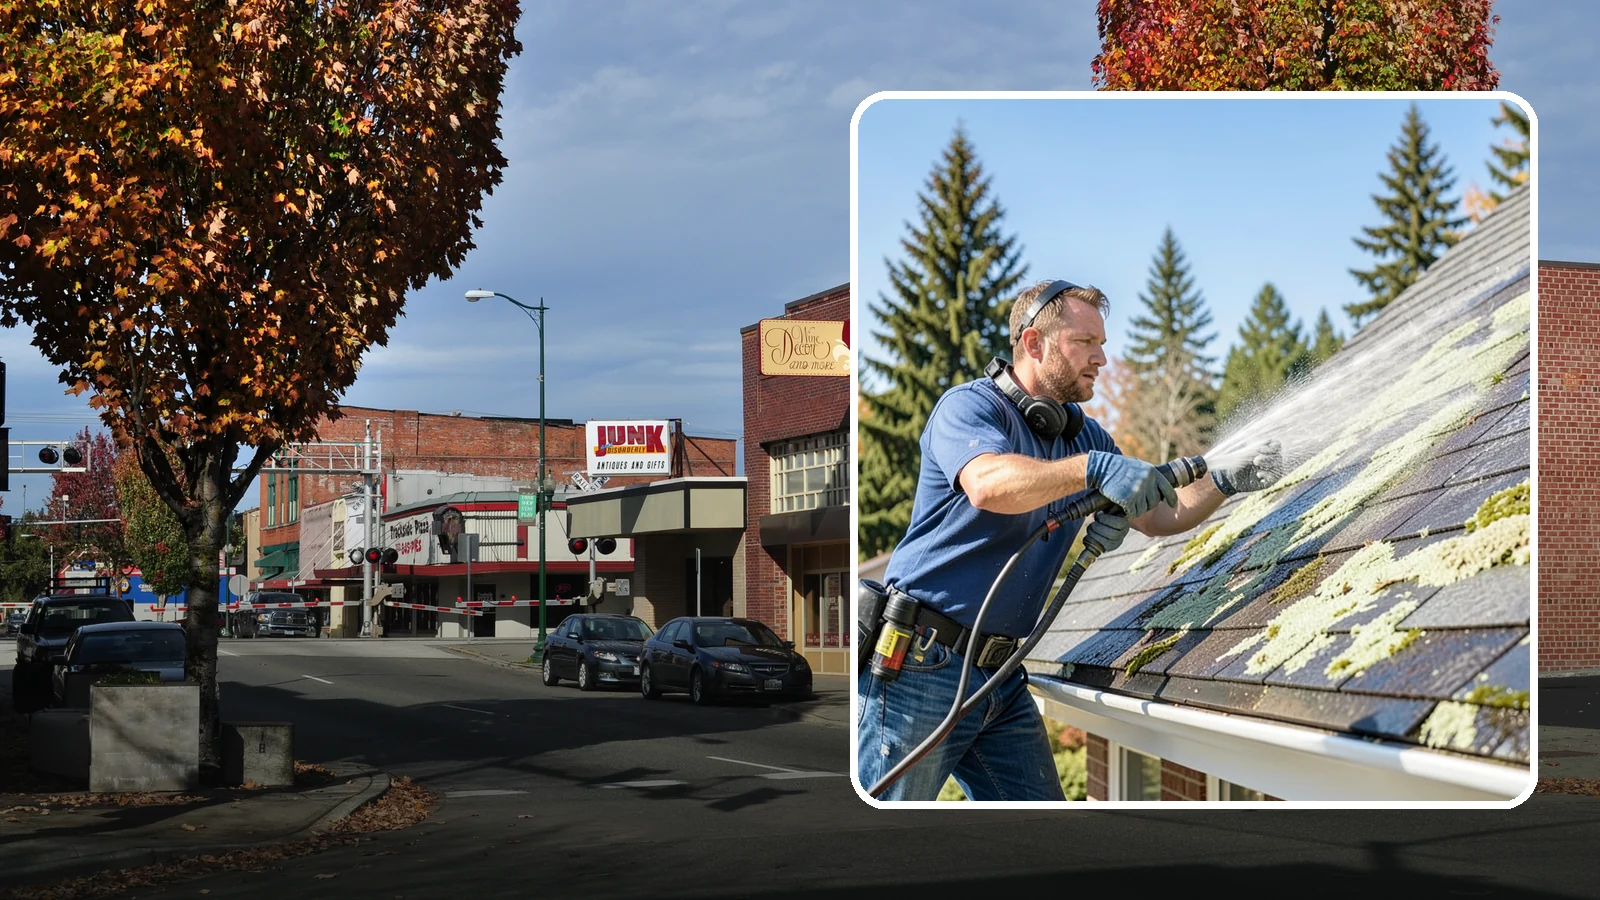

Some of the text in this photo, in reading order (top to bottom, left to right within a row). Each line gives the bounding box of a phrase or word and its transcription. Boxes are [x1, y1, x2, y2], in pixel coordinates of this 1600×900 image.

[595, 425, 665, 457] JUNK
[607, 446, 646, 454] DISORDERLY
[597, 460, 666, 470] ANTIQUES AND GIFTS
[352, 498, 364, 511] CRO
[414, 519, 429, 535] Pizza
